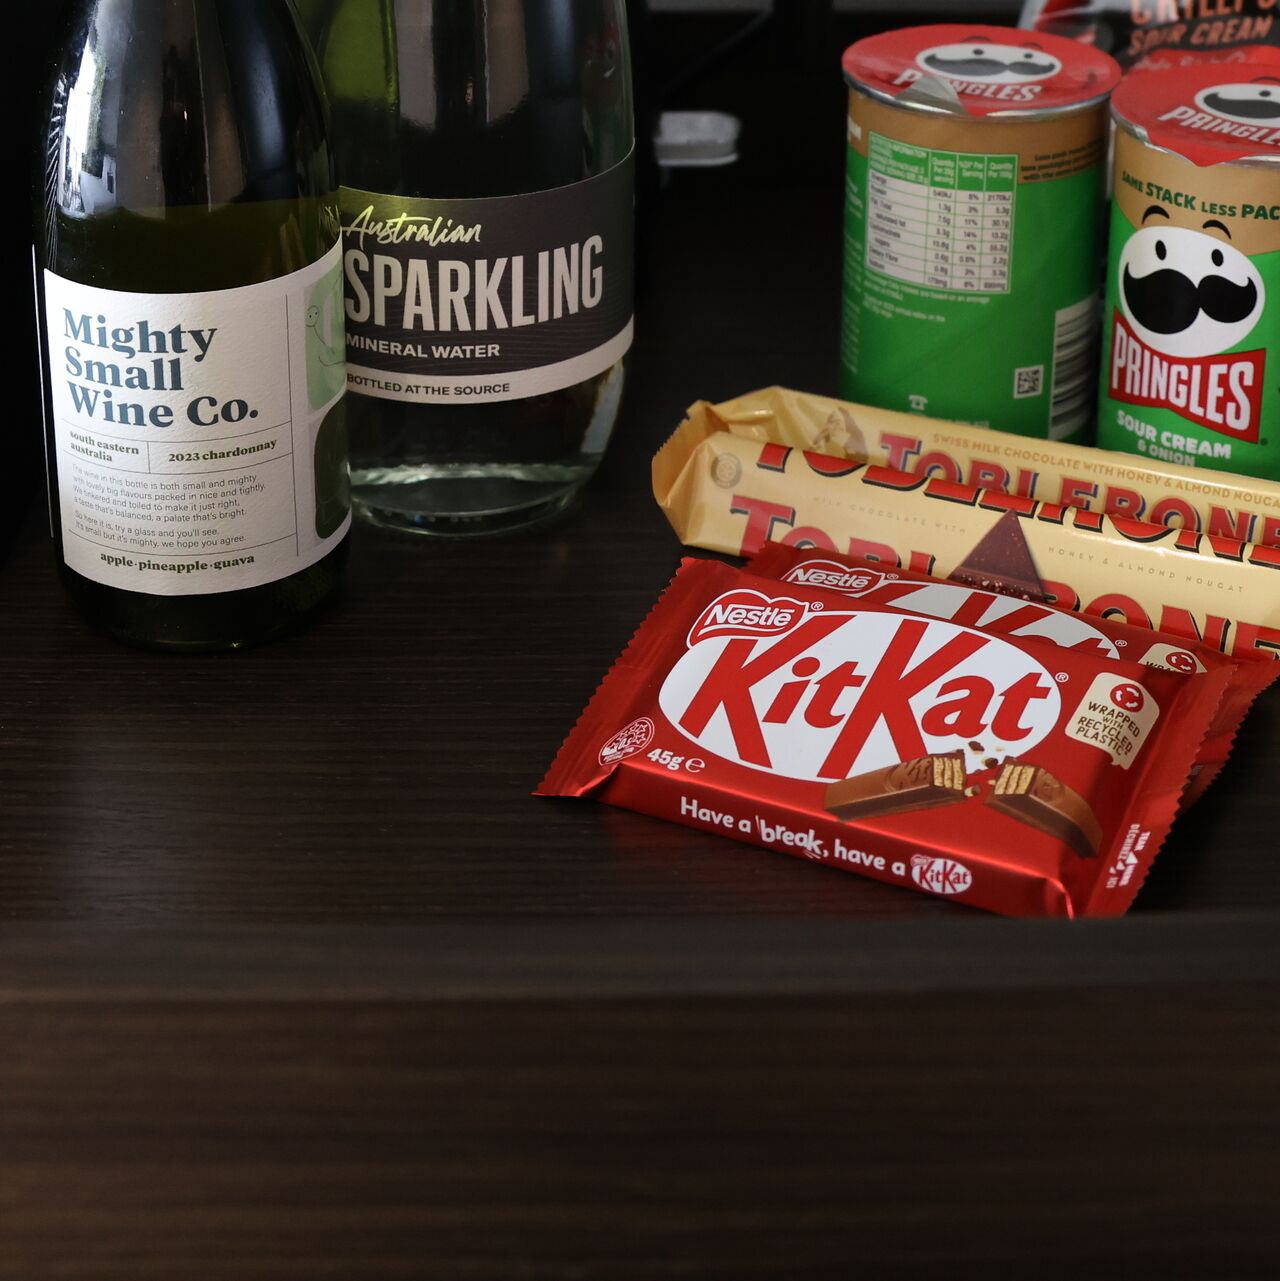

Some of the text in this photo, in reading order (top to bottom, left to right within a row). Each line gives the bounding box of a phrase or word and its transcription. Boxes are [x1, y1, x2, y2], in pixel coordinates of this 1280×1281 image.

[1128, 16, 1273, 55] SOUR CREAM
[892, 69, 1042, 101] PNGLES
[1122, 171, 1144, 192] SAME
[1146, 182, 1196, 210] STACK
[1201, 201, 1236, 217] LESS
[342, 204, 482, 250] Australian
[344, 234, 603, 331] SPARKLING
[63, 308, 217, 362] Mighty
[346, 333, 500, 359] MINERAL WATER
[65, 346, 184, 391] Small
[347, 373, 510, 396] BOTTLED AT THE SOURCE
[1112, 323, 1254, 431] PRINGLES
[67, 381, 258, 428] Wine Co.
[70, 431, 139, 455] south eastern
[70, 442, 112, 462] australia
[169, 440, 277, 461] 2023 chardonnay
[1117, 410, 1232, 460] SOUR CREAM
[933, 433, 969, 449] SWISS
[972, 442, 1001, 455] MILK
[1004, 447, 1080, 469] CHOCOLATE
[1083, 461, 1114, 475] WITH
[1118, 467, 1160, 486] HONEY
[1164, 478, 1172, 488] &
[1176, 481, 1230, 499] ALMOND
[1150, 444, 1195, 467] ONION
[120, 489, 152, 500] flavours
[155, 493, 186, 502] packed
[200, 490, 218, 499] nice
[221, 489, 236, 497] and
[125, 480, 148, 489] bottle
[183, 482, 205, 490] small
[209, 480, 225, 488] and
[228, 475, 257, 486] mighty
[112, 499, 127, 507] and
[129, 501, 151, 510] toiled
[199, 502, 215, 512] just
[164, 514, 191, 522] palate
[192, 511, 217, 521] that's
[849, 504, 926, 526] CHOCOLATE
[936, 523, 966, 534] WITH
[103, 531, 115, 540] but
[177, 540, 199, 549] hope
[201, 540, 217, 549] you
[115, 524, 125, 533] try
[134, 527, 155, 537] glass
[158, 529, 174, 537] and
[1048, 547, 1094, 561] HONEY
[1118, 562, 1175, 578] ALMOND
[1186, 576, 1245, 593] NOUGAT
[679, 614, 1051, 781] KitKat
[1078, 716, 1133, 753] RECYCLED
[1088, 701, 1140, 738] WRAPPED
[647, 748, 685, 771] 45g
[681, 797, 734, 829] Have
[738, 818, 752, 833] a
[760, 819, 829, 857] break,
[834, 839, 886, 870] have
[891, 862, 905, 876] a
[920, 861, 968, 892] KitKat
